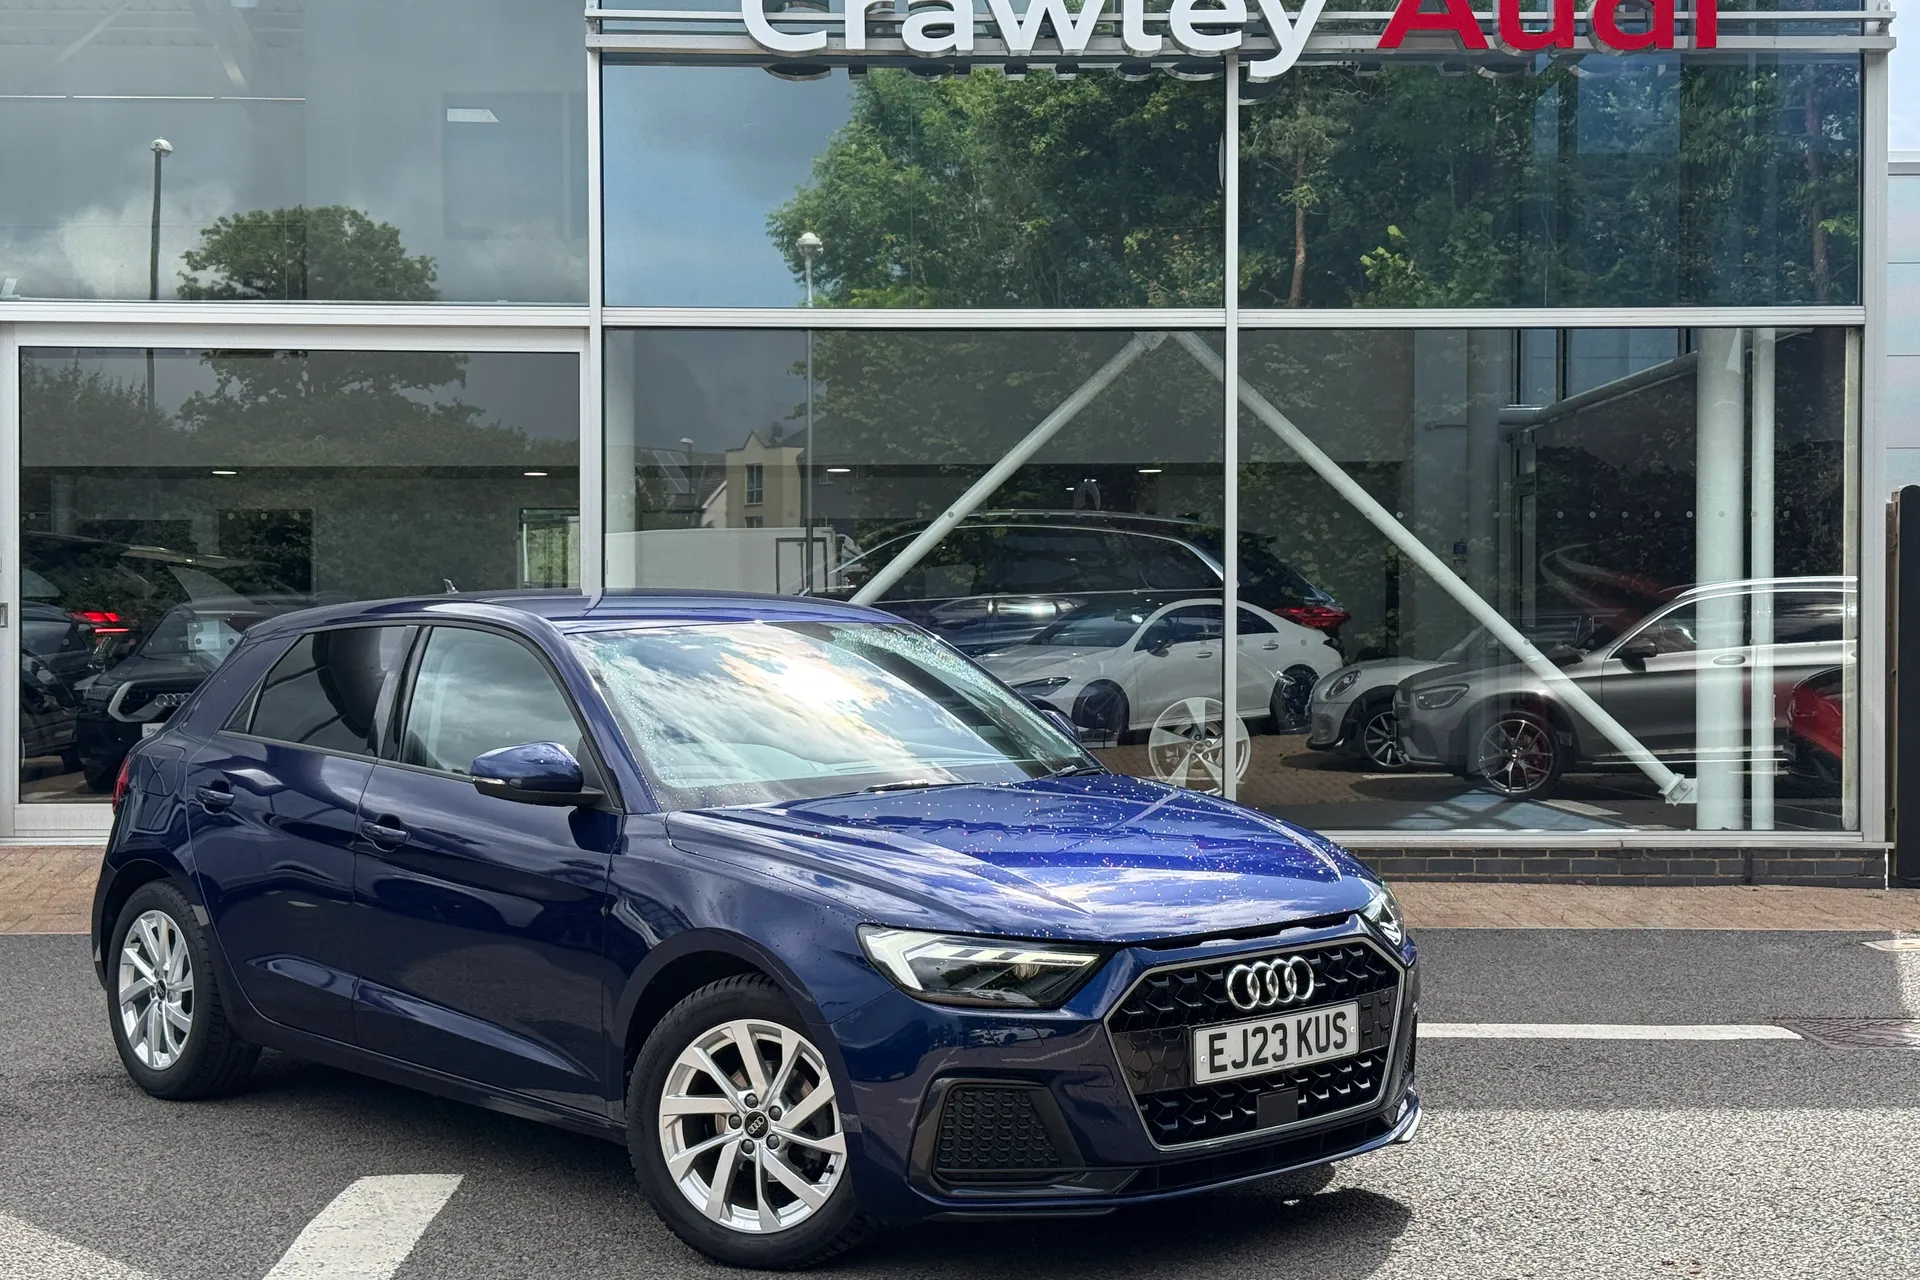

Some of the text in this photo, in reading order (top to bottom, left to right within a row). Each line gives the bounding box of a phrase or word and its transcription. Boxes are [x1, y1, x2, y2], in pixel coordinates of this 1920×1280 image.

[742, 0, 1717, 77] Crawley Audi
[1208, 1011, 1347, 1074] EJ23 KUS
